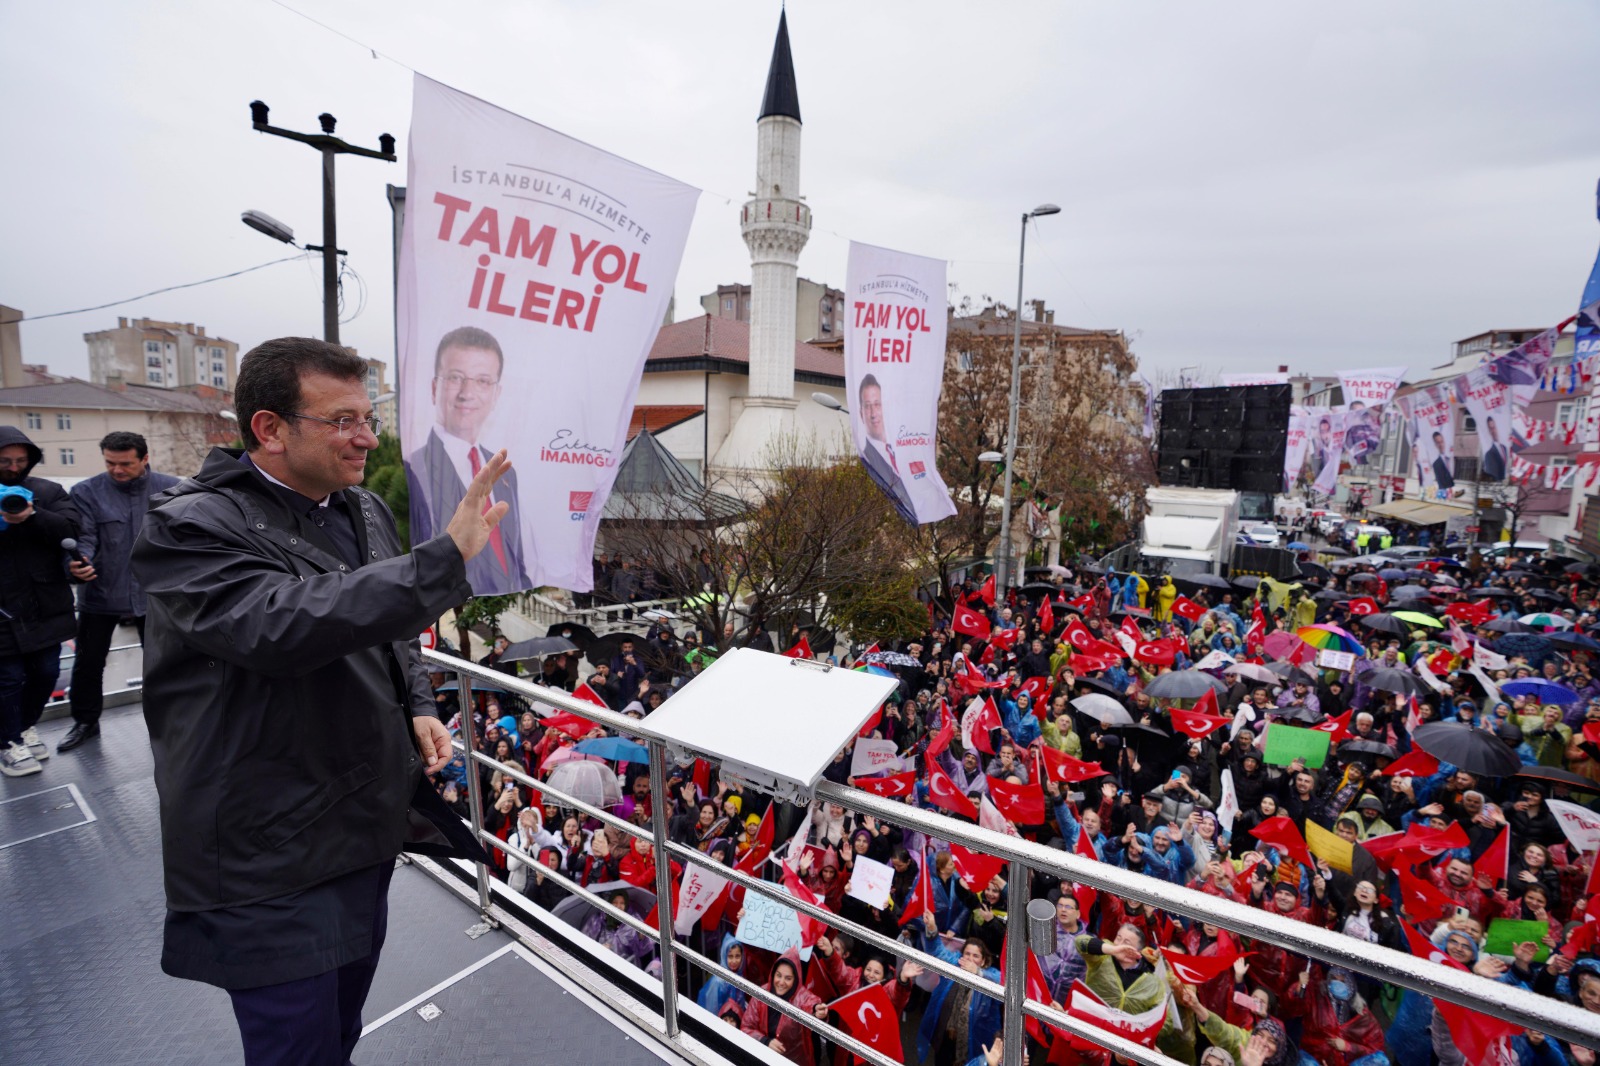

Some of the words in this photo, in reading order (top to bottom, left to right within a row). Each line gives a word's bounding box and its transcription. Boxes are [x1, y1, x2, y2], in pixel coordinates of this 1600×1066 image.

[452, 165, 572, 202] İSTANBUL'A
[579, 193, 652, 245] HİZMETTE
[433, 191, 558, 268] TAM
[569, 232, 648, 294] YOL
[467, 253, 605, 333] İLERİ
[854, 301, 892, 329] TAM
[896, 305, 931, 332] YOL
[866, 329, 912, 363] İLERİ
[1343, 380, 1374, 388] TAM
[1375, 381, 1399, 391] YOL
[1355, 389, 1388, 400] İLERİ
[571, 512, 586, 522] CH
[761, 914, 786, 933] EKO
